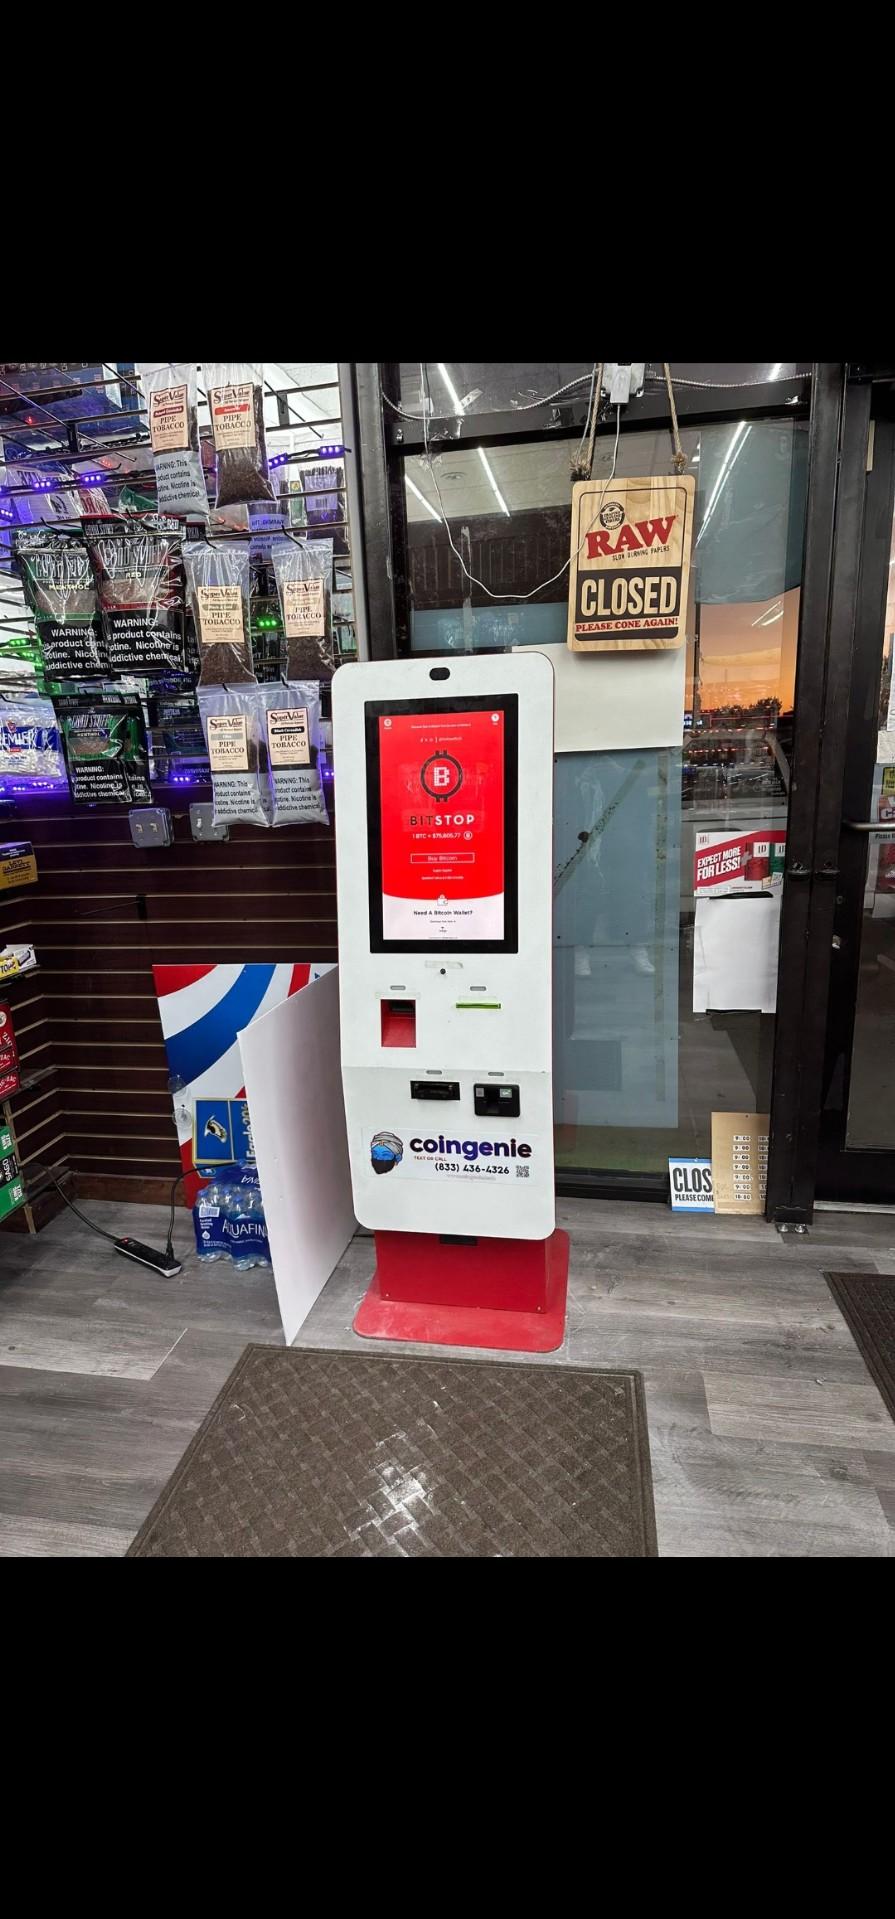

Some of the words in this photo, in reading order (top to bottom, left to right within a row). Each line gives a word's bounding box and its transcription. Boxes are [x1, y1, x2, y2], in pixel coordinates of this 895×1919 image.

[160, 416, 176, 424] PIPE
[224, 414, 242, 422] PIPE
[152, 422, 184, 432] TOBACCO
[216, 421, 252, 431] TOBACCO
[170, 481, 190, 490] Nicotine
[586, 515, 676, 560] RAW
[628, 550, 648, 559] BURNING
[651, 546, 670, 554] PAPERS
[581, 576, 678, 616] CLOSED
[114, 618, 158, 628] WARNING:
[576, 620, 612, 632] PLEASE
[615, 620, 640, 630] CONE
[644, 618, 678, 627] AGAIN!
[51, 628, 98, 637] WARNING:
[112, 632, 144, 642] product
[145, 631, 182, 640] contains
[136, 640, 171, 650] Nicotine
[146, 652, 183, 663] chemical.
[698, 852, 722, 868] EXPECT
[722, 846, 742, 860] MORE
[697, 868, 714, 882] FOR
[716, 856, 740, 876] LESS!
[410, 1135, 532, 1160] coingenie
[435, 1163, 460, 1172] (833)
[463, 1164, 510, 1174] 436-4326
[672, 1168, 712, 1193] CLOS
[675, 1194, 696, 1202] PLEASE
